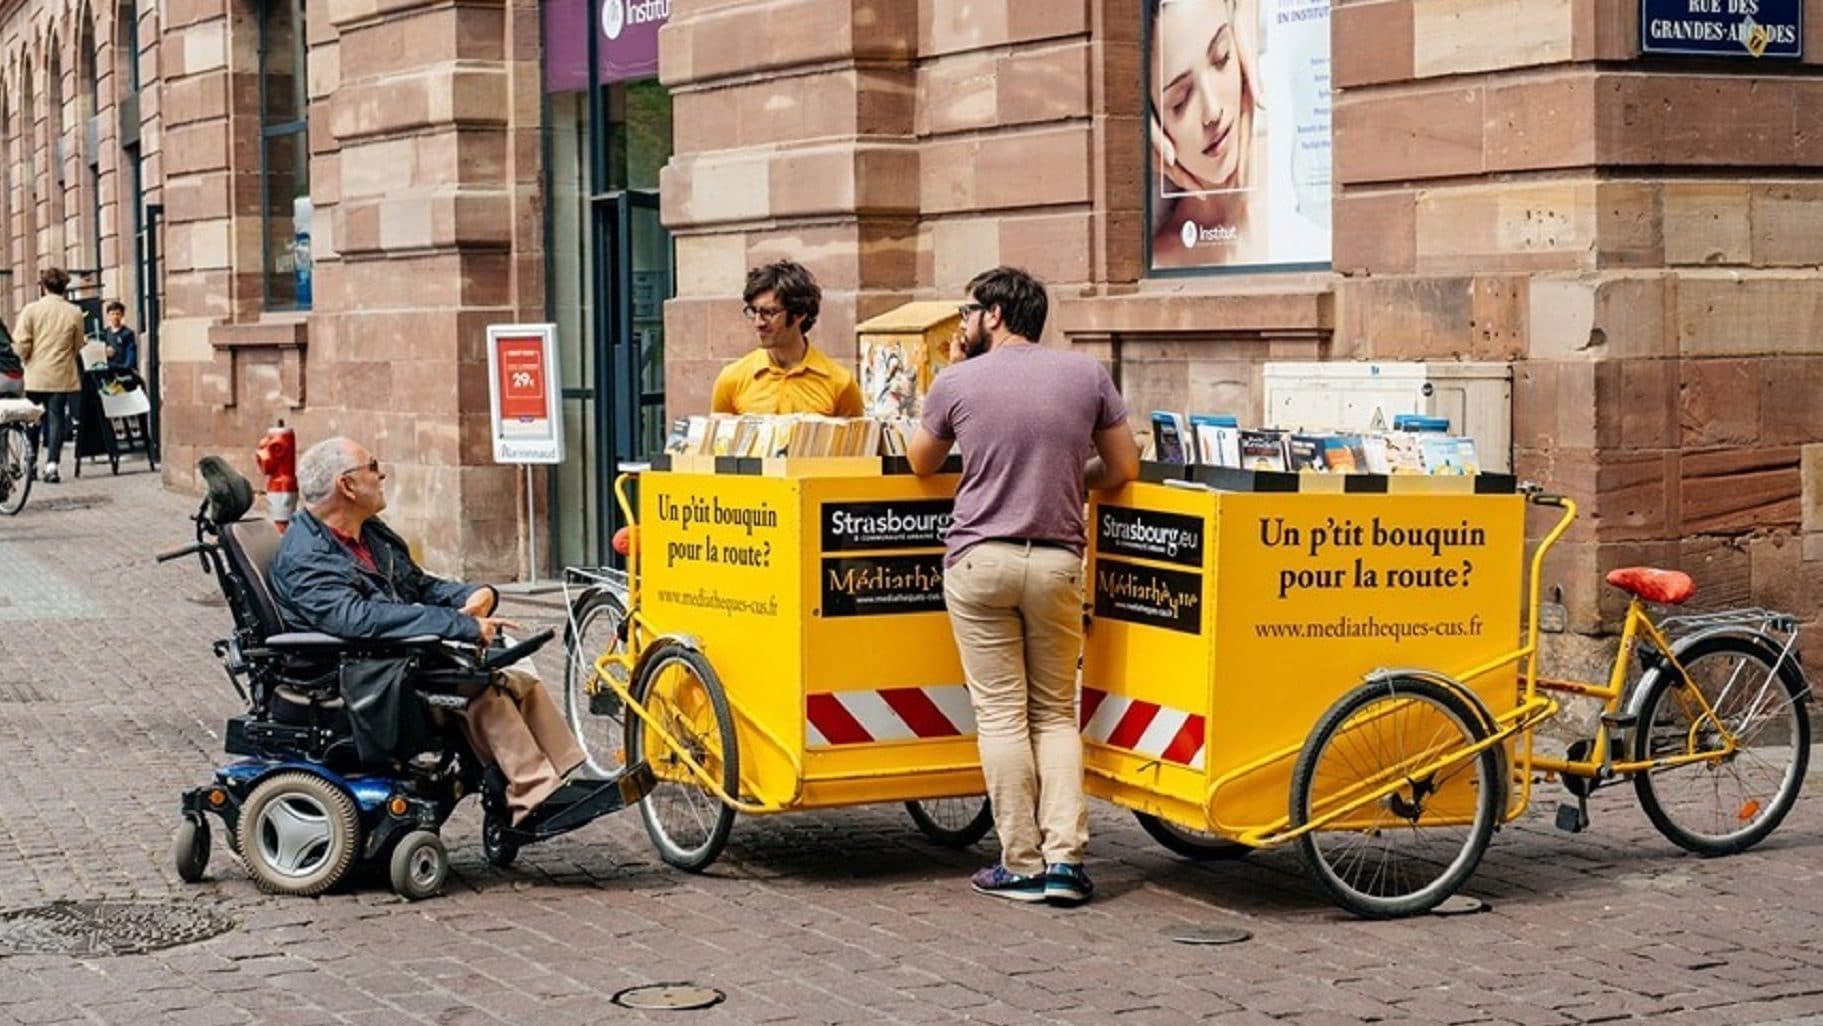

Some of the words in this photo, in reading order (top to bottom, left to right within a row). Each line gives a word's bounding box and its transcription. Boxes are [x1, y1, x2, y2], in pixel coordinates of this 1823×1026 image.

[1688, 0, 1720, 13] RUE
[1728, 0, 1759, 15] DES
[658, 494, 678, 521] Un
[682, 495, 710, 530] p'tit
[714, 496, 777, 536] bouquin
[668, 541, 702, 568] pour
[706, 535, 718, 562] la
[1103, 514, 1198, 557] Strasbourg.eu
[1259, 518, 1300, 546] Un
[1309, 517, 1363, 556] p'tit
[1372, 518, 1486, 556] bouquin
[1279, 568, 1346, 599] pour
[1354, 558, 1377, 588] la
[1254, 614, 1483, 643] www.mediatheques-cus.fr
